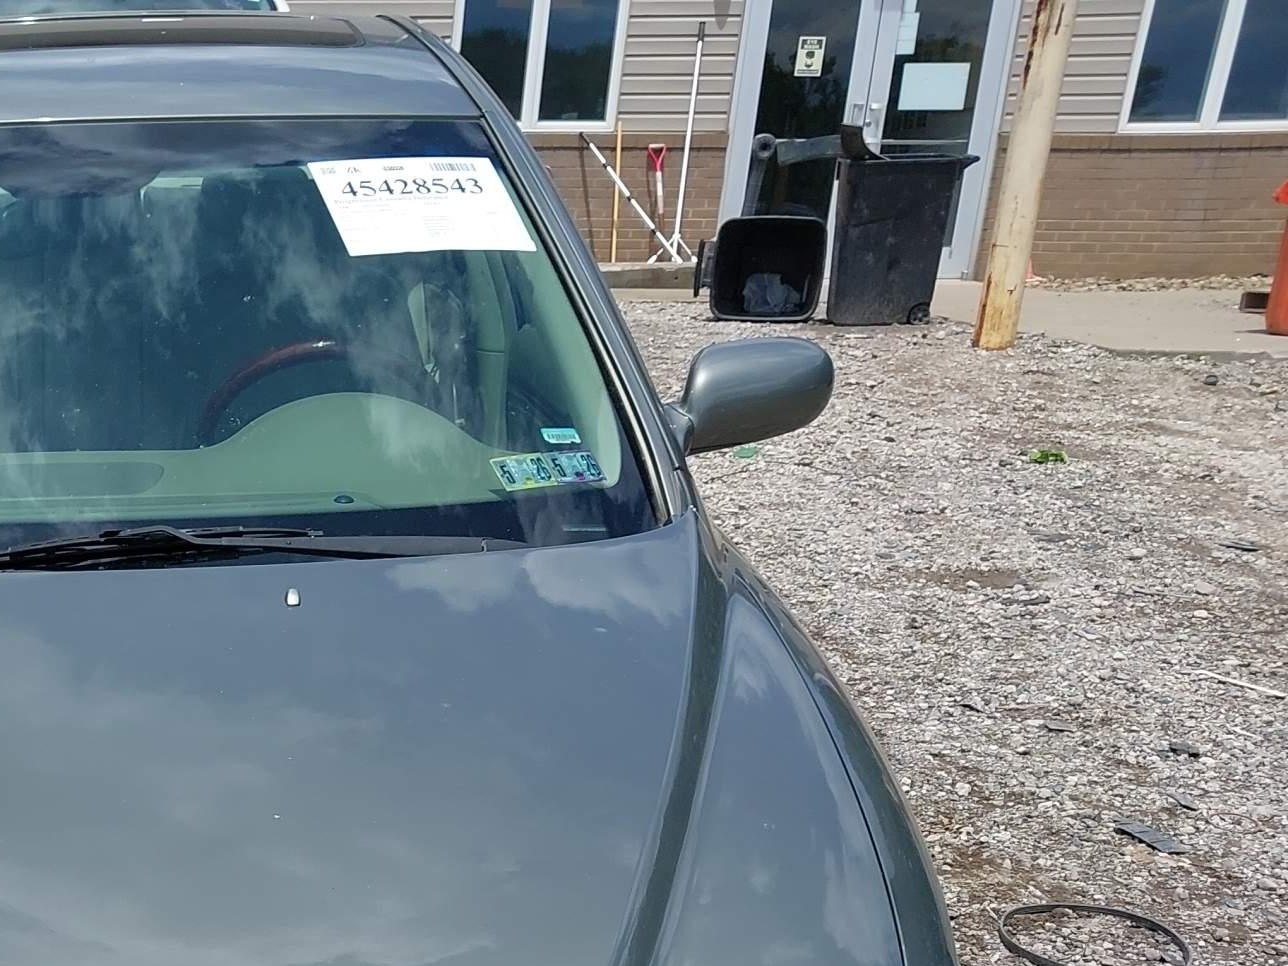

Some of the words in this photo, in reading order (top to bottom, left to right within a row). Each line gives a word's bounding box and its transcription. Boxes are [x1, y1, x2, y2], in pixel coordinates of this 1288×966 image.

[341, 177, 484, 197] 45428543
[499, 464, 517, 484] 5
[551, 457, 567, 478] 5
